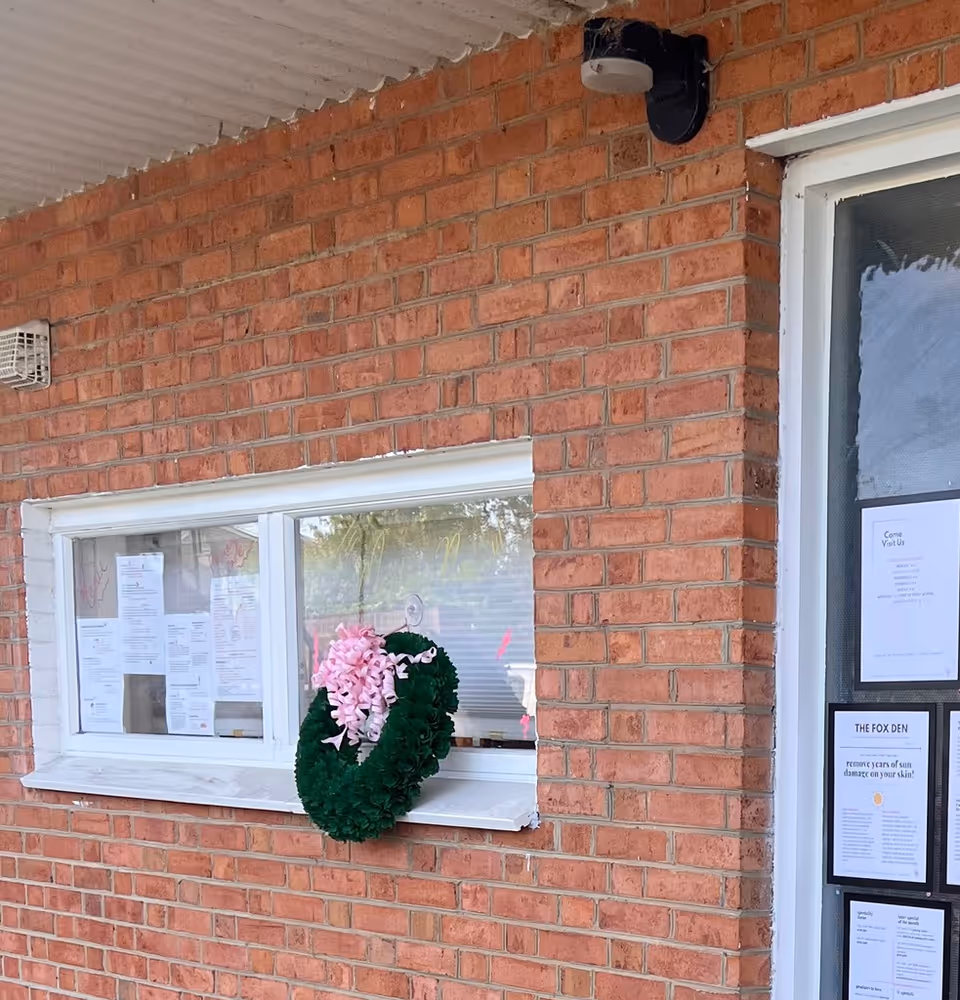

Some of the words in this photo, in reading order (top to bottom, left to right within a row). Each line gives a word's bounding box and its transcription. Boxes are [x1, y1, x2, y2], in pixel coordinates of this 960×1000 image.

[884, 530, 903, 539] Come
[881, 539, 896, 547] Visit
[896, 538, 905, 546] Us
[855, 723, 870, 733] THE
[871, 723, 889, 733] FOX
[891, 723, 908, 733] DEN
[846, 760, 870, 768] remove
[871, 760, 890, 769] years
[891, 759, 899, 768] of
[843, 768, 869, 778] damage
[879, 771, 896, 780] your
[897, 769, 915, 779] skin!
